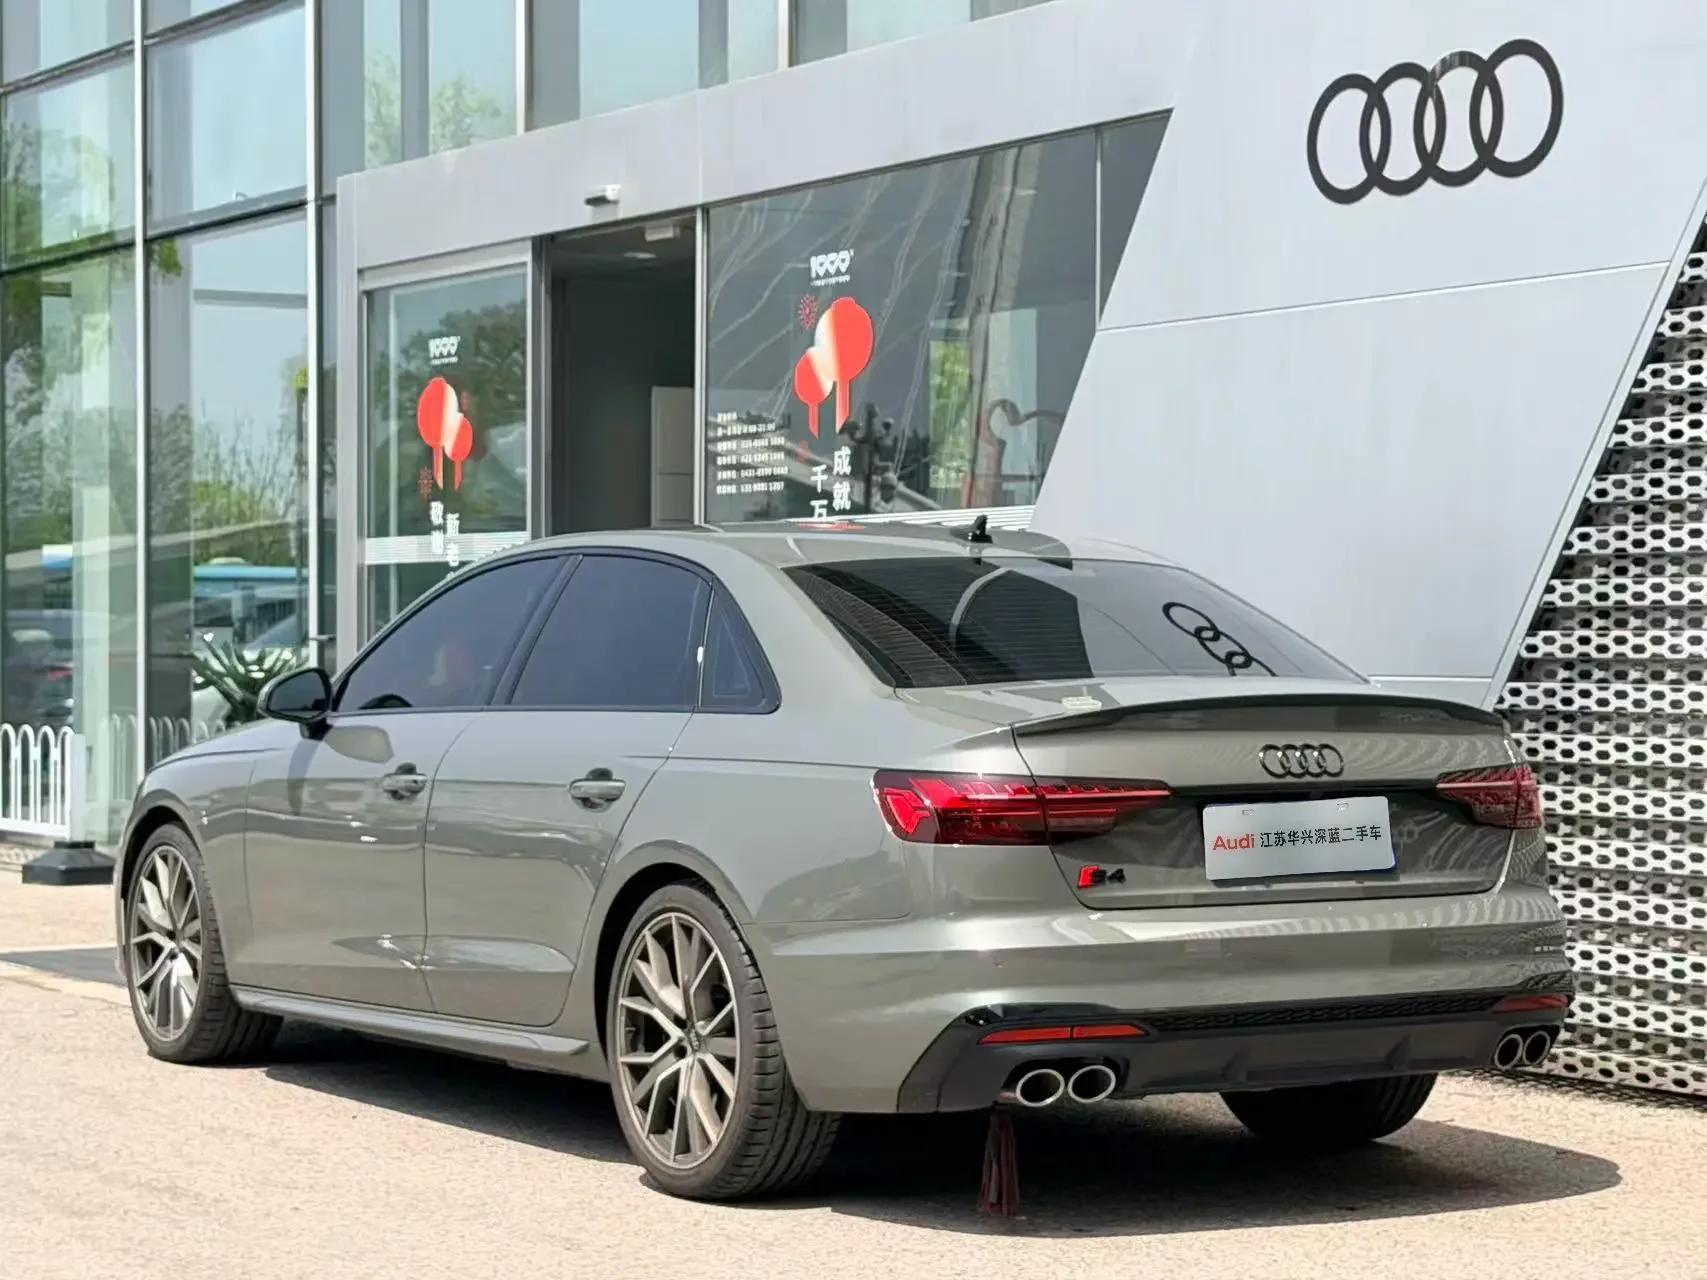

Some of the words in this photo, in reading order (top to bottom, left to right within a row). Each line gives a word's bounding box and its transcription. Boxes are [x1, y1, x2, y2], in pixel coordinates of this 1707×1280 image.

[832, 446, 852, 511] 成就
[1212, 833, 1256, 851] Audi
[1259, 824, 1382, 848] 江苏华兴深蓝二手车
